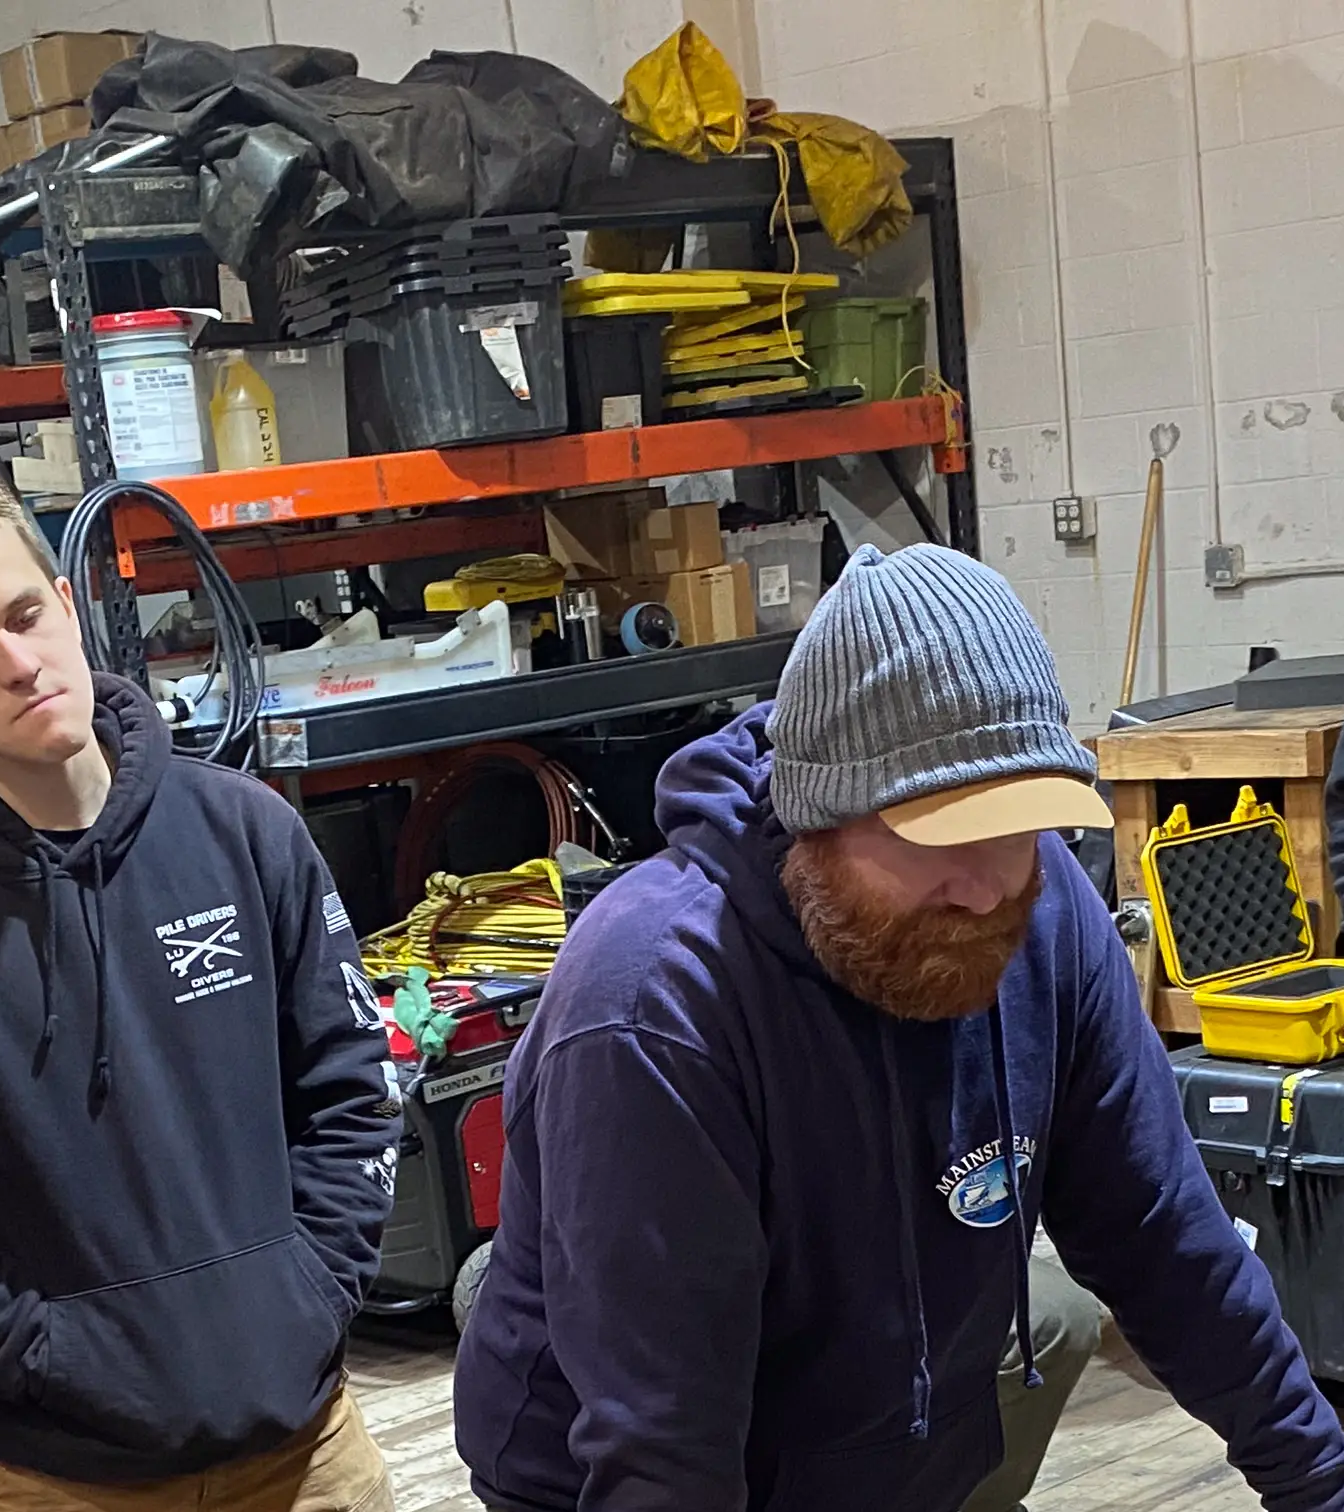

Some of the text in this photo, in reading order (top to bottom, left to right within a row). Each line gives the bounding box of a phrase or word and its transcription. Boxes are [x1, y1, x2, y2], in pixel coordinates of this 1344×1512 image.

[314, 674, 378, 697] Falcon
[155, 904, 237, 939] PILE DRIVERS
[165, 948, 184, 960] LU
[191, 968, 234, 988] DIVERS
[430, 1075, 482, 1096] HONDA
[935, 1136, 1036, 1197] MAINSTEA
